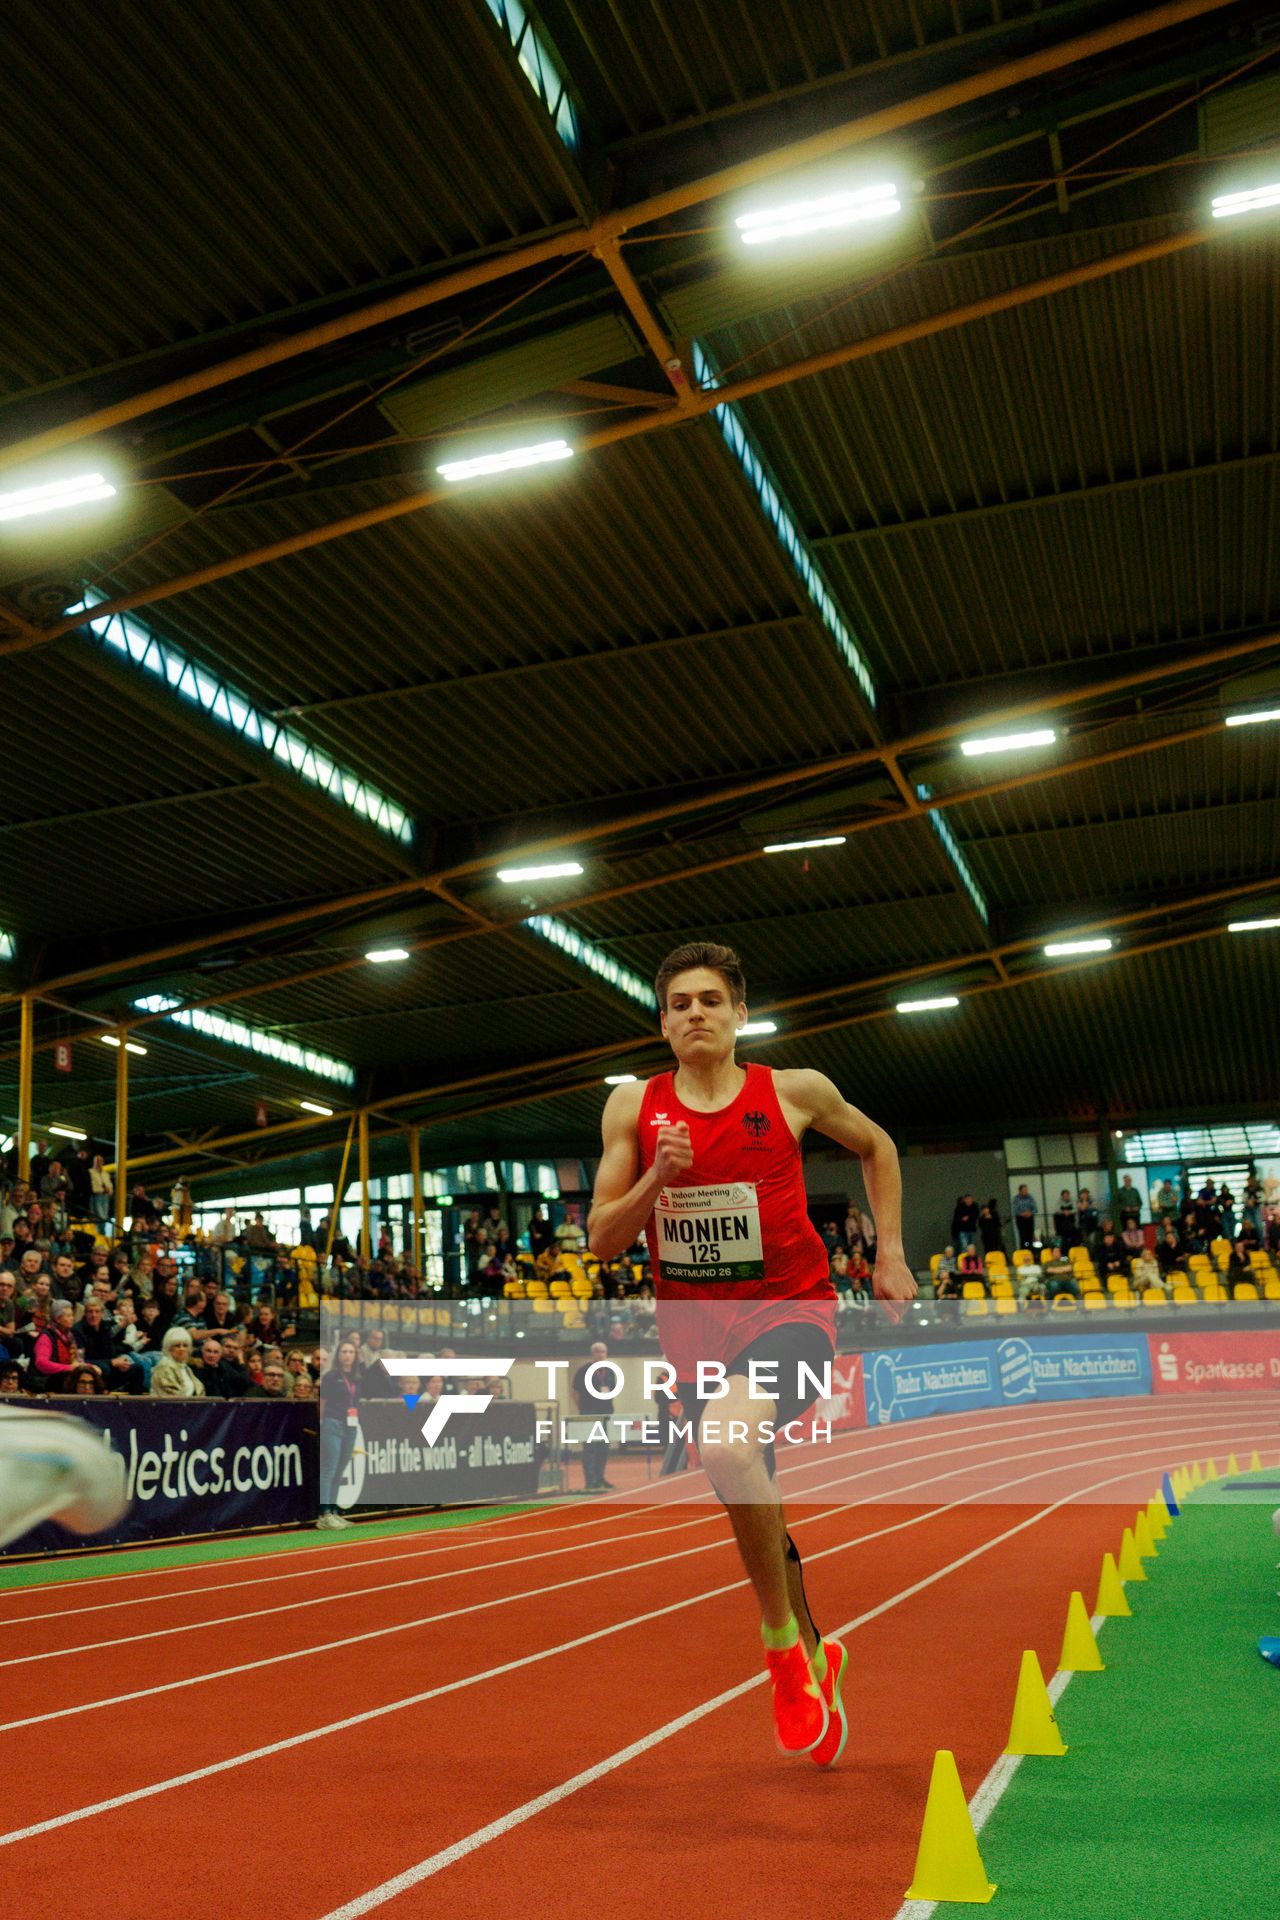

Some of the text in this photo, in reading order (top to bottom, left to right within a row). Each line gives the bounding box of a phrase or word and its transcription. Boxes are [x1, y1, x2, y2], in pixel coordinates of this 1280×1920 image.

[58, 1046, 68, 1066] B
[671, 1188, 730, 1199] Indoor Meeting
[672, 1200, 712, 1208] Dortmund
[663, 1215, 749, 1243] MONIEN
[689, 1243, 721, 1263] 125
[666, 1266, 717, 1277] DORTMUND
[718, 1267, 732, 1276] 26
[1033, 1357, 1060, 1378] Ruhr
[1063, 1355, 1137, 1376] Nachrichten
[1184, 1358, 1265, 1384] Sparkasse
[895, 1371, 921, 1395] Ruhr
[922, 1365, 988, 1390] Nachrichten
[368, 1438, 396, 1475] Half
[399, 1438, 421, 1472] the
[468, 1435, 482, 1468] all
[484, 1435, 502, 1467] the
